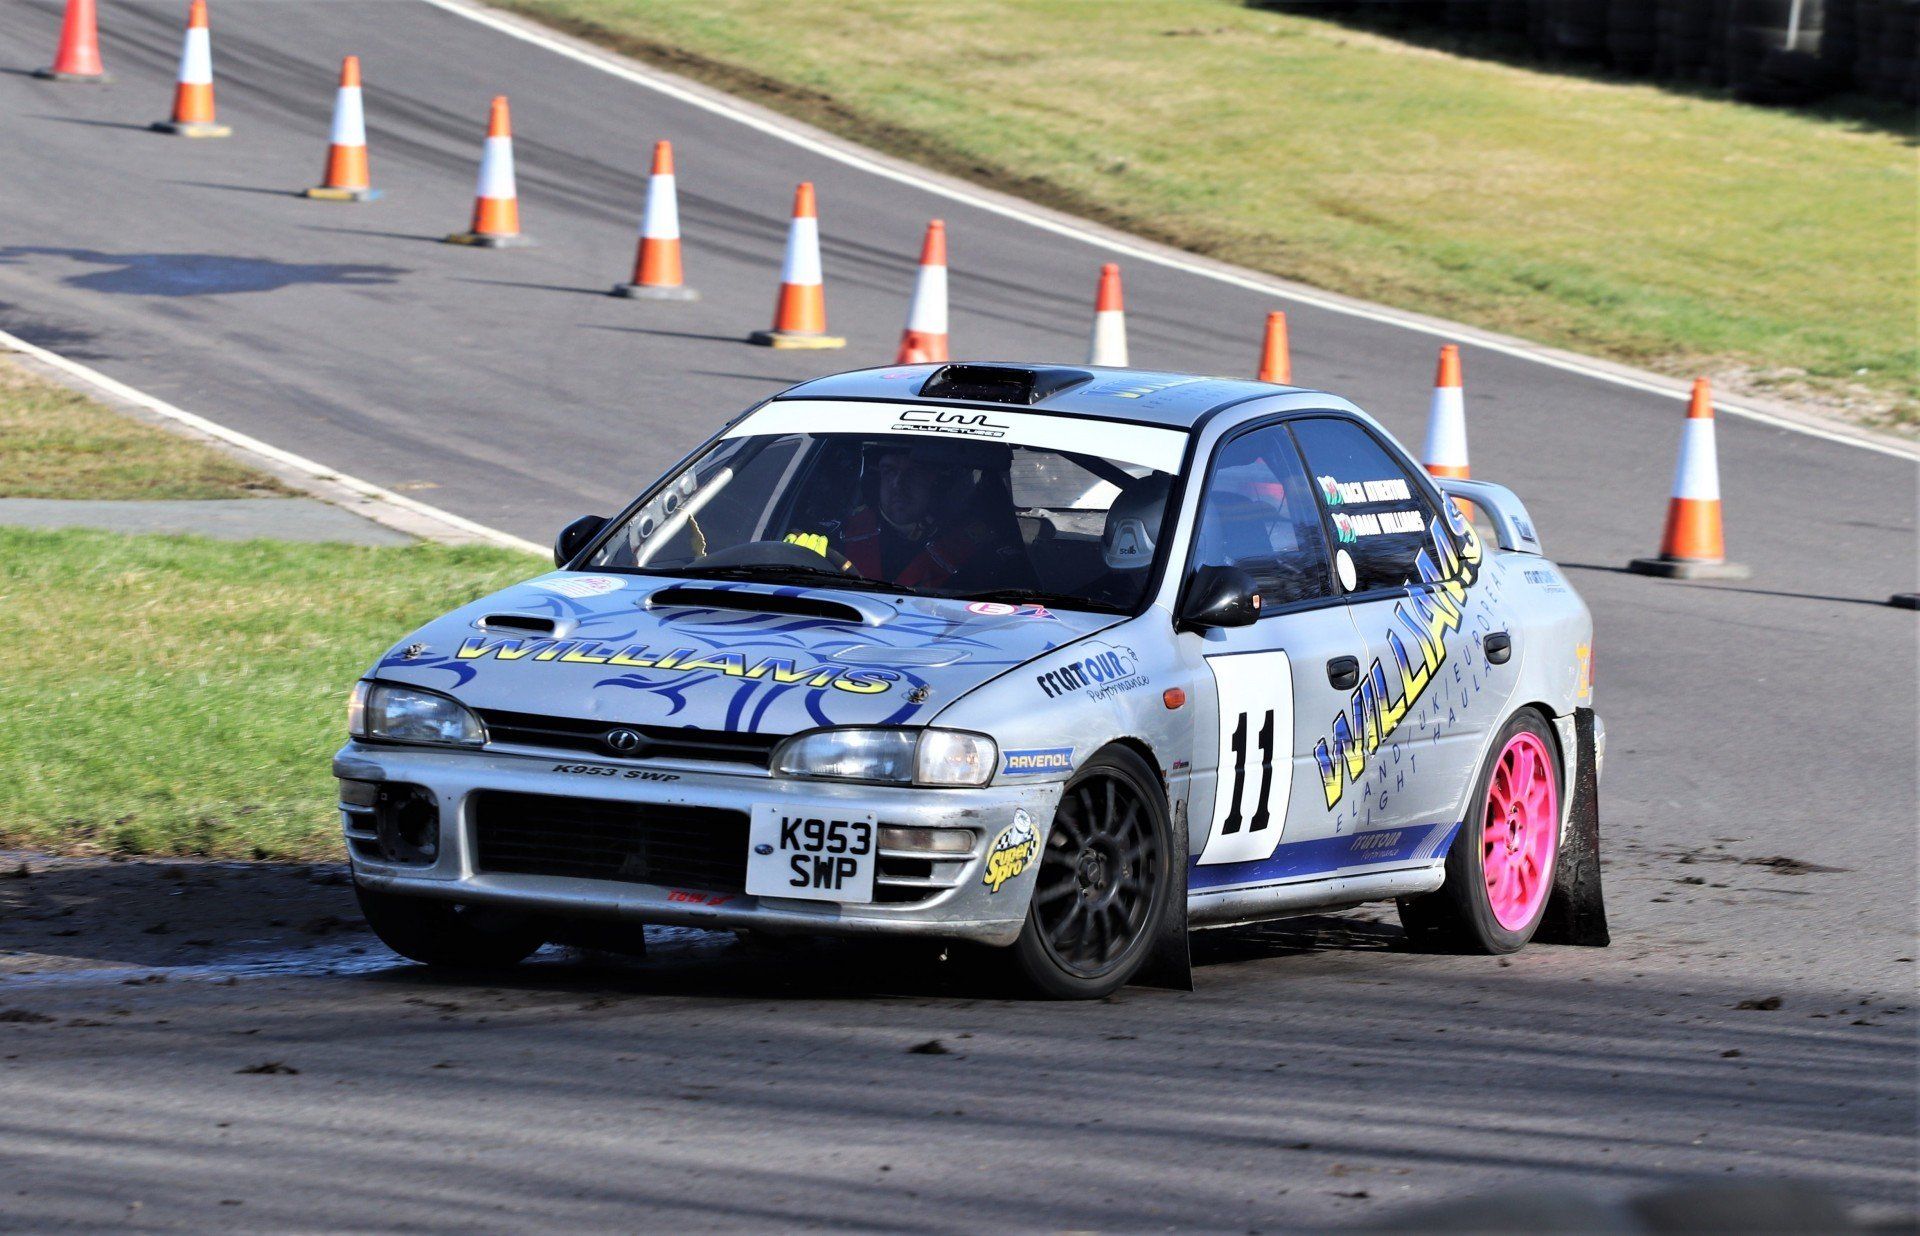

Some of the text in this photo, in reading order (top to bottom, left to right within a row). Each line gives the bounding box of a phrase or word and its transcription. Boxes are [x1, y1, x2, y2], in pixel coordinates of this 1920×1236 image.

[454, 636, 901, 695] WILLIAMS
[1313, 490, 1483, 813] WILLIAMS
[1087, 675, 1150, 704] Performance
[552, 764, 682, 783] K953 SWP
[1009, 753, 1069, 769] RAVENOL
[1221, 709, 1275, 836] 11
[780, 816, 872, 856] K953
[789, 854, 858, 890] SWP
